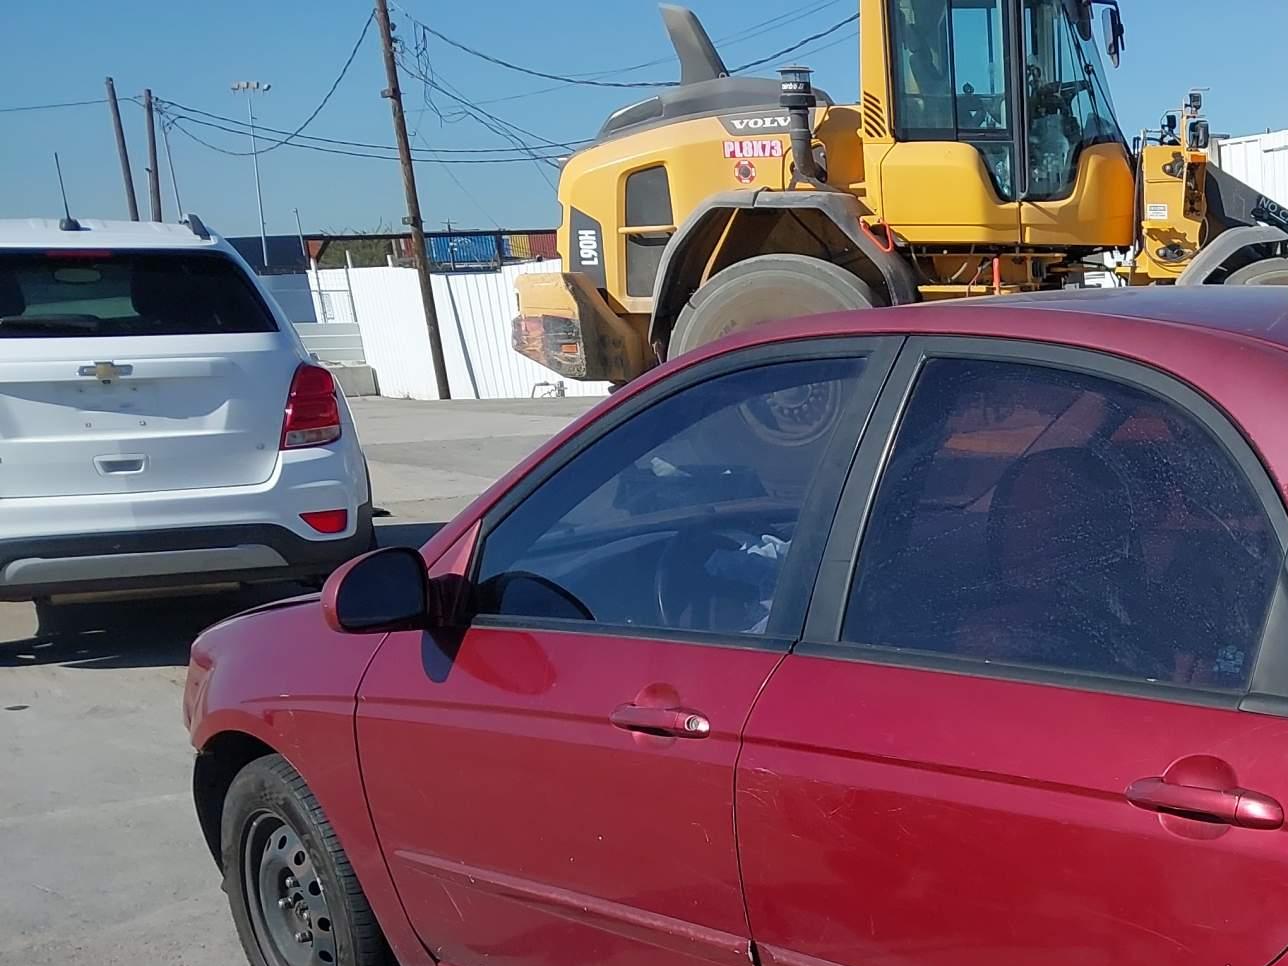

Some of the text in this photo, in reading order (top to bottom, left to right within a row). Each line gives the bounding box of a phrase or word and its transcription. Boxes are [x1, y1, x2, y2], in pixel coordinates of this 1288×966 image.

[731, 116, 791, 129] VOLV
[1259, 197, 1278, 213] NO
[578, 229, 599, 266] L90H
